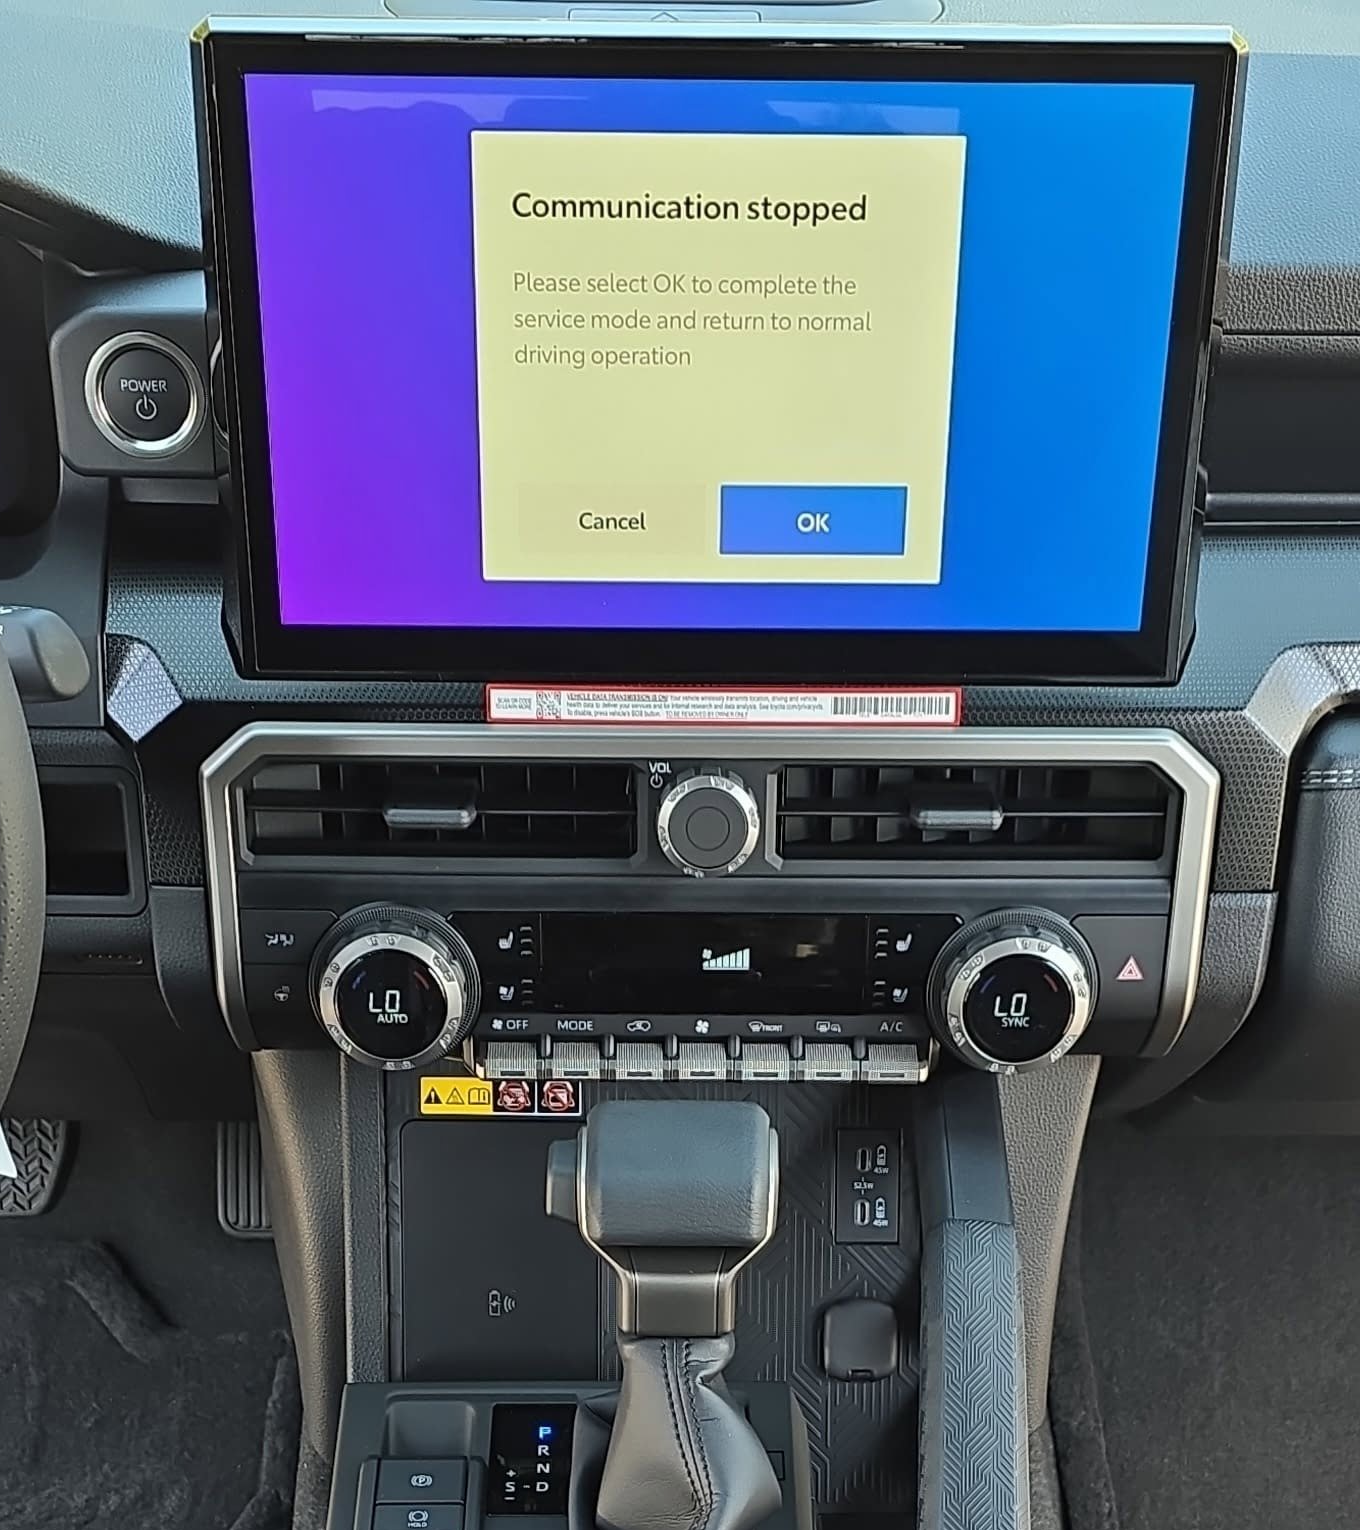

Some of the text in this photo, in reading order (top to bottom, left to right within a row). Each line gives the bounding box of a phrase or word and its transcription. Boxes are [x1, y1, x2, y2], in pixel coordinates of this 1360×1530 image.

[512, 192, 867, 226] Communication stopped
[513, 272, 857, 300] Please select OK to complete the
[513, 309, 872, 332] service mode and return to normal
[514, 344, 692, 369] driving operation
[120, 378, 168, 392] POWER
[578, 511, 646, 531] Cancel
[796, 513, 830, 533] OK
[649, 760, 672, 773] VOL
[369, 990, 400, 1013] LO
[994, 993, 1028, 1017] LO
[377, 1013, 408, 1024] AUTO
[1002, 1017, 1030, 1028] SYNC
[506, 1020, 529, 1030] OFF
[557, 1020, 593, 1031] MODE
[761, 1024, 783, 1032] FRONT
[880, 1021, 903, 1033] A/C
[539, 1427, 552, 1439] P
[537, 1445, 550, 1456] R
[537, 1463, 550, 1473] N
[505, 1482, 516, 1492] S
[536, 1482, 549, 1492] D
